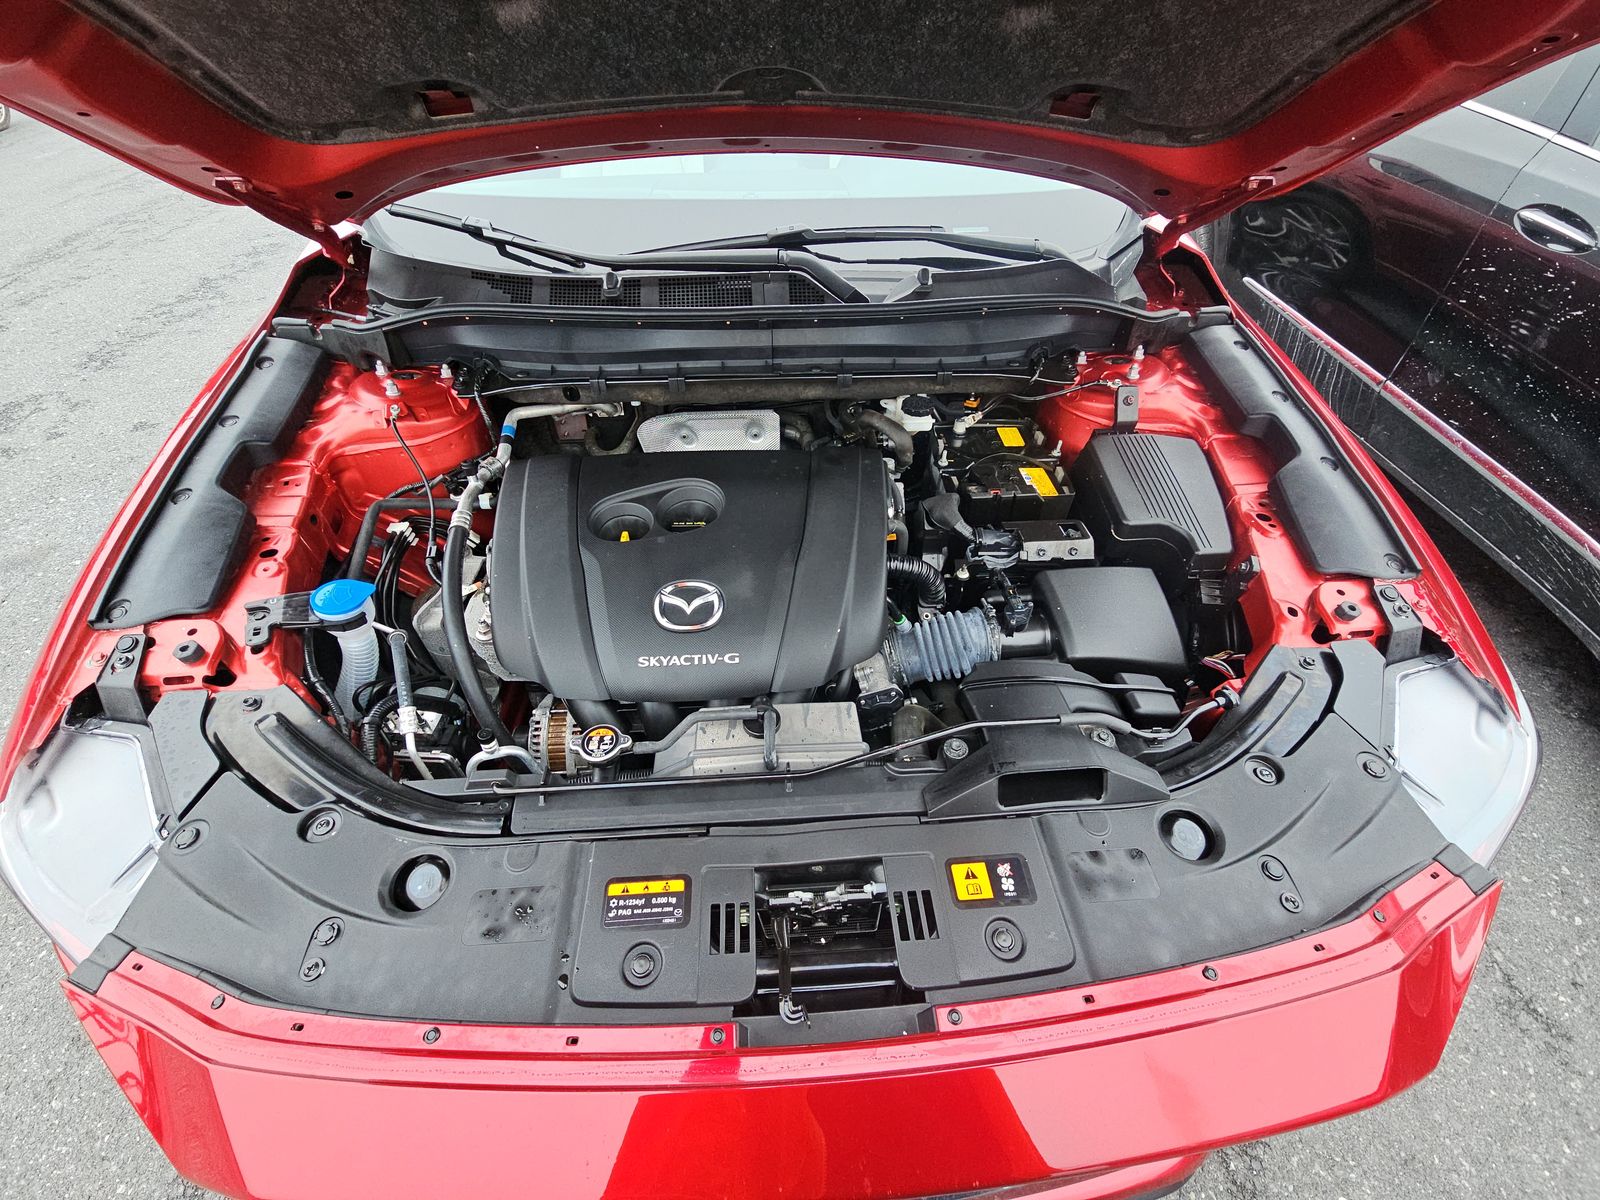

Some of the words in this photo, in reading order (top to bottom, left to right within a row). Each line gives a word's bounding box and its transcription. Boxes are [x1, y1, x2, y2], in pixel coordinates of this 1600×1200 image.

[637, 653, 740, 667] SKYACTIV-G
[618, 898, 645, 906] R-1234yf
[668, 896, 677, 904] kg
